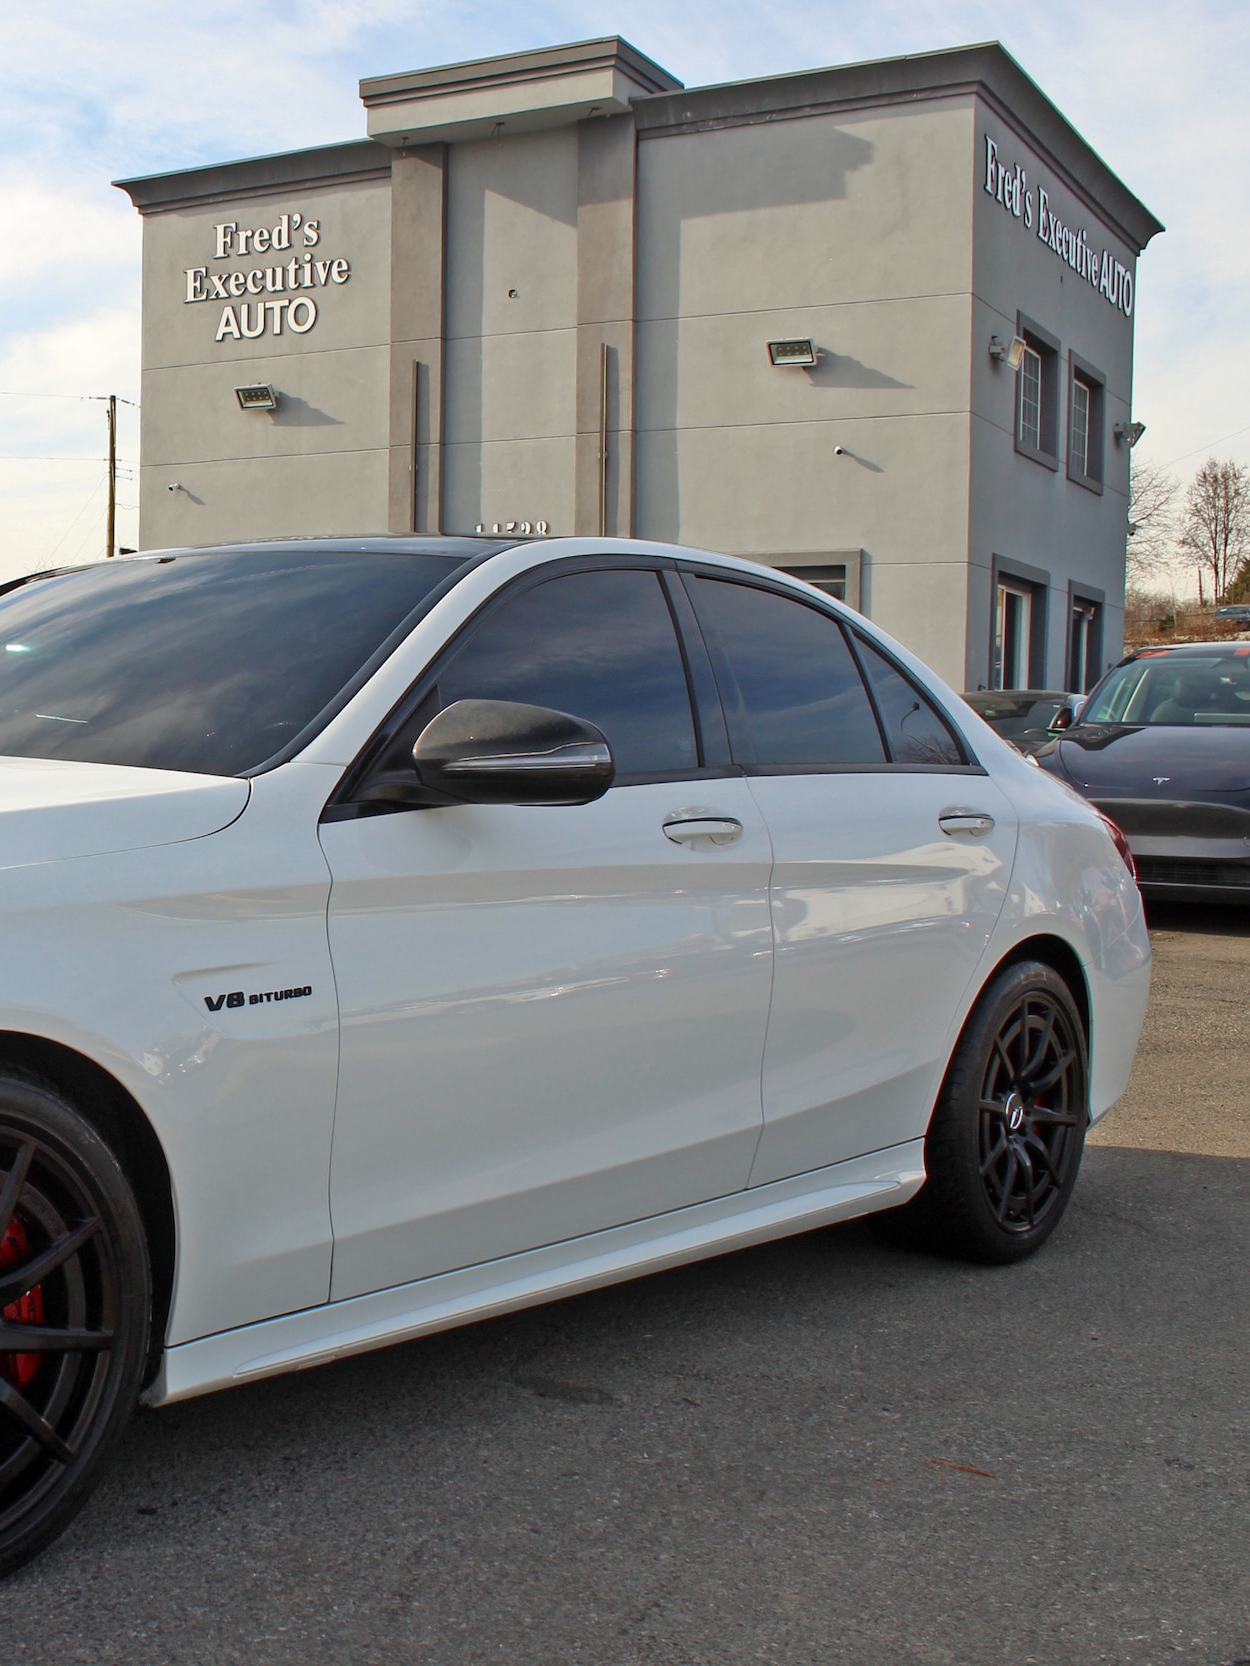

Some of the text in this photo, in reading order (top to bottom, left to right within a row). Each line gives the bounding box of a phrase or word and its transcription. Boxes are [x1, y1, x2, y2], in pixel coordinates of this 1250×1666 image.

[212, 212, 320, 259] Fred's
[984, 133, 1133, 317] Fred's Executive AUTO
[183, 252, 350, 304] Executive
[214, 296, 318, 342] AUTO
[204, 985, 312, 1012] V8 BITURBO
